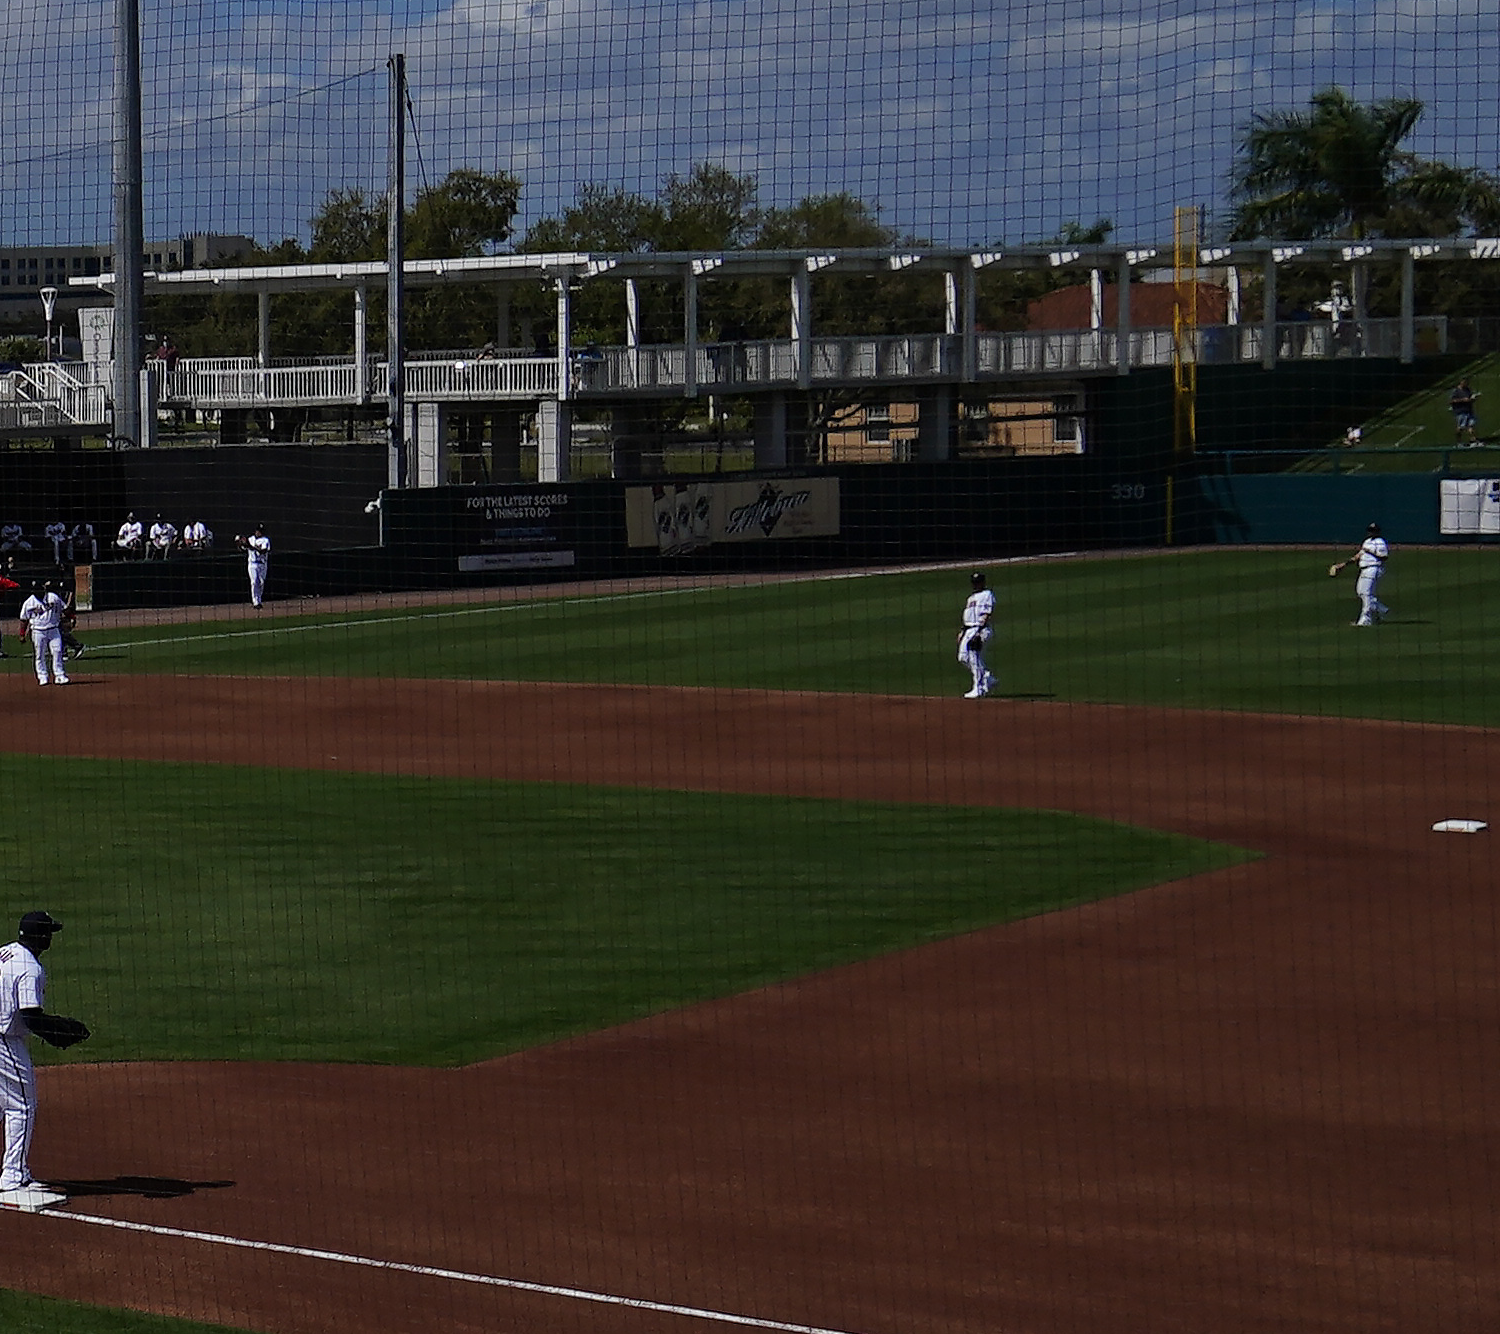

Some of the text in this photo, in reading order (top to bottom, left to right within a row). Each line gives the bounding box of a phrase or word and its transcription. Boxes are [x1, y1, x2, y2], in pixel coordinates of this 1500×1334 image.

[466, 493, 569, 509] FOR THE LATEST SCORES
[494, 507, 523, 519] THINGS
[524, 507, 536, 518] TO
[537, 507, 551, 518] DO
